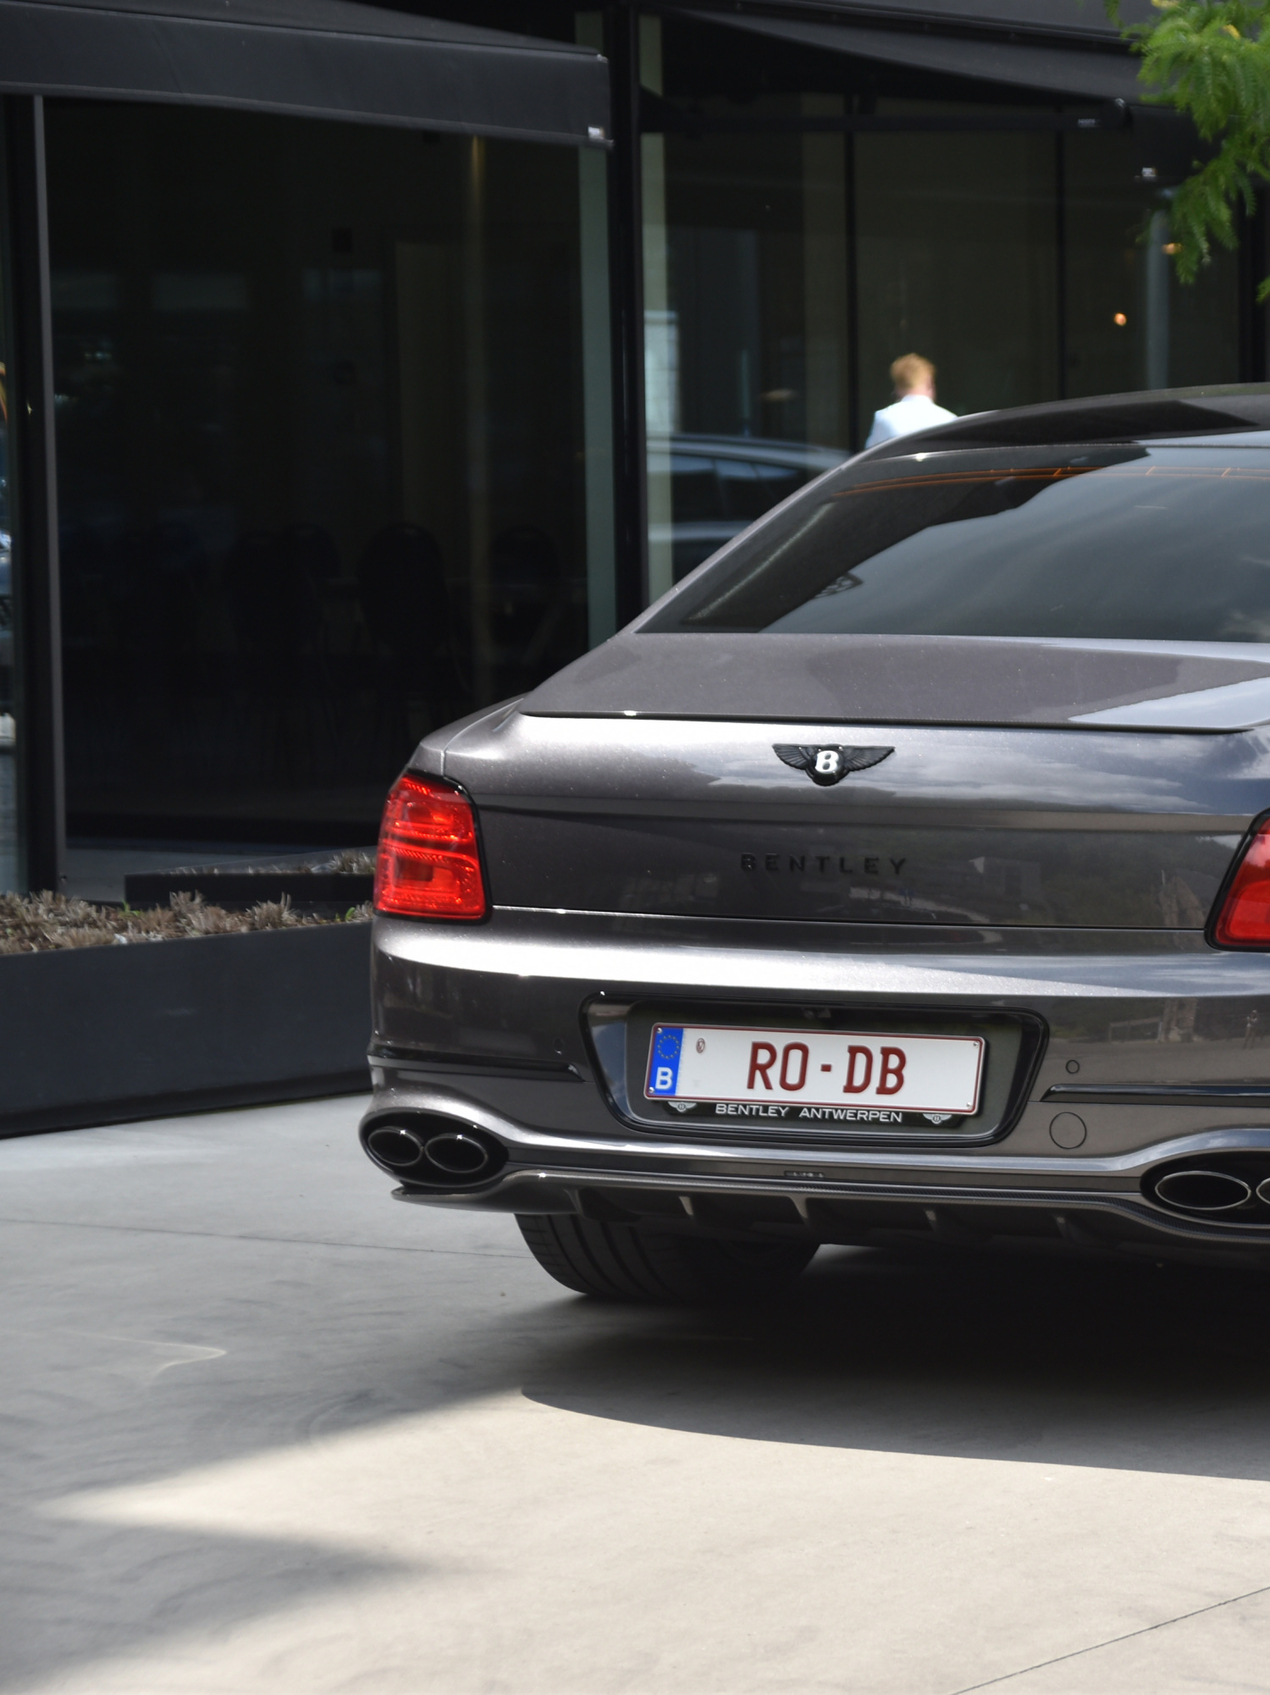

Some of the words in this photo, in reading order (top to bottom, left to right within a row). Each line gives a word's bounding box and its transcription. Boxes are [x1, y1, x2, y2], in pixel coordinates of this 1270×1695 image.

[815, 750, 839, 774] B
[741, 853, 906, 875] BENTLEY
[655, 1067, 673, 1090] B
[715, 1103, 789, 1117] BENTLEY
[798, 1108, 903, 1123] ANTWERPEN
